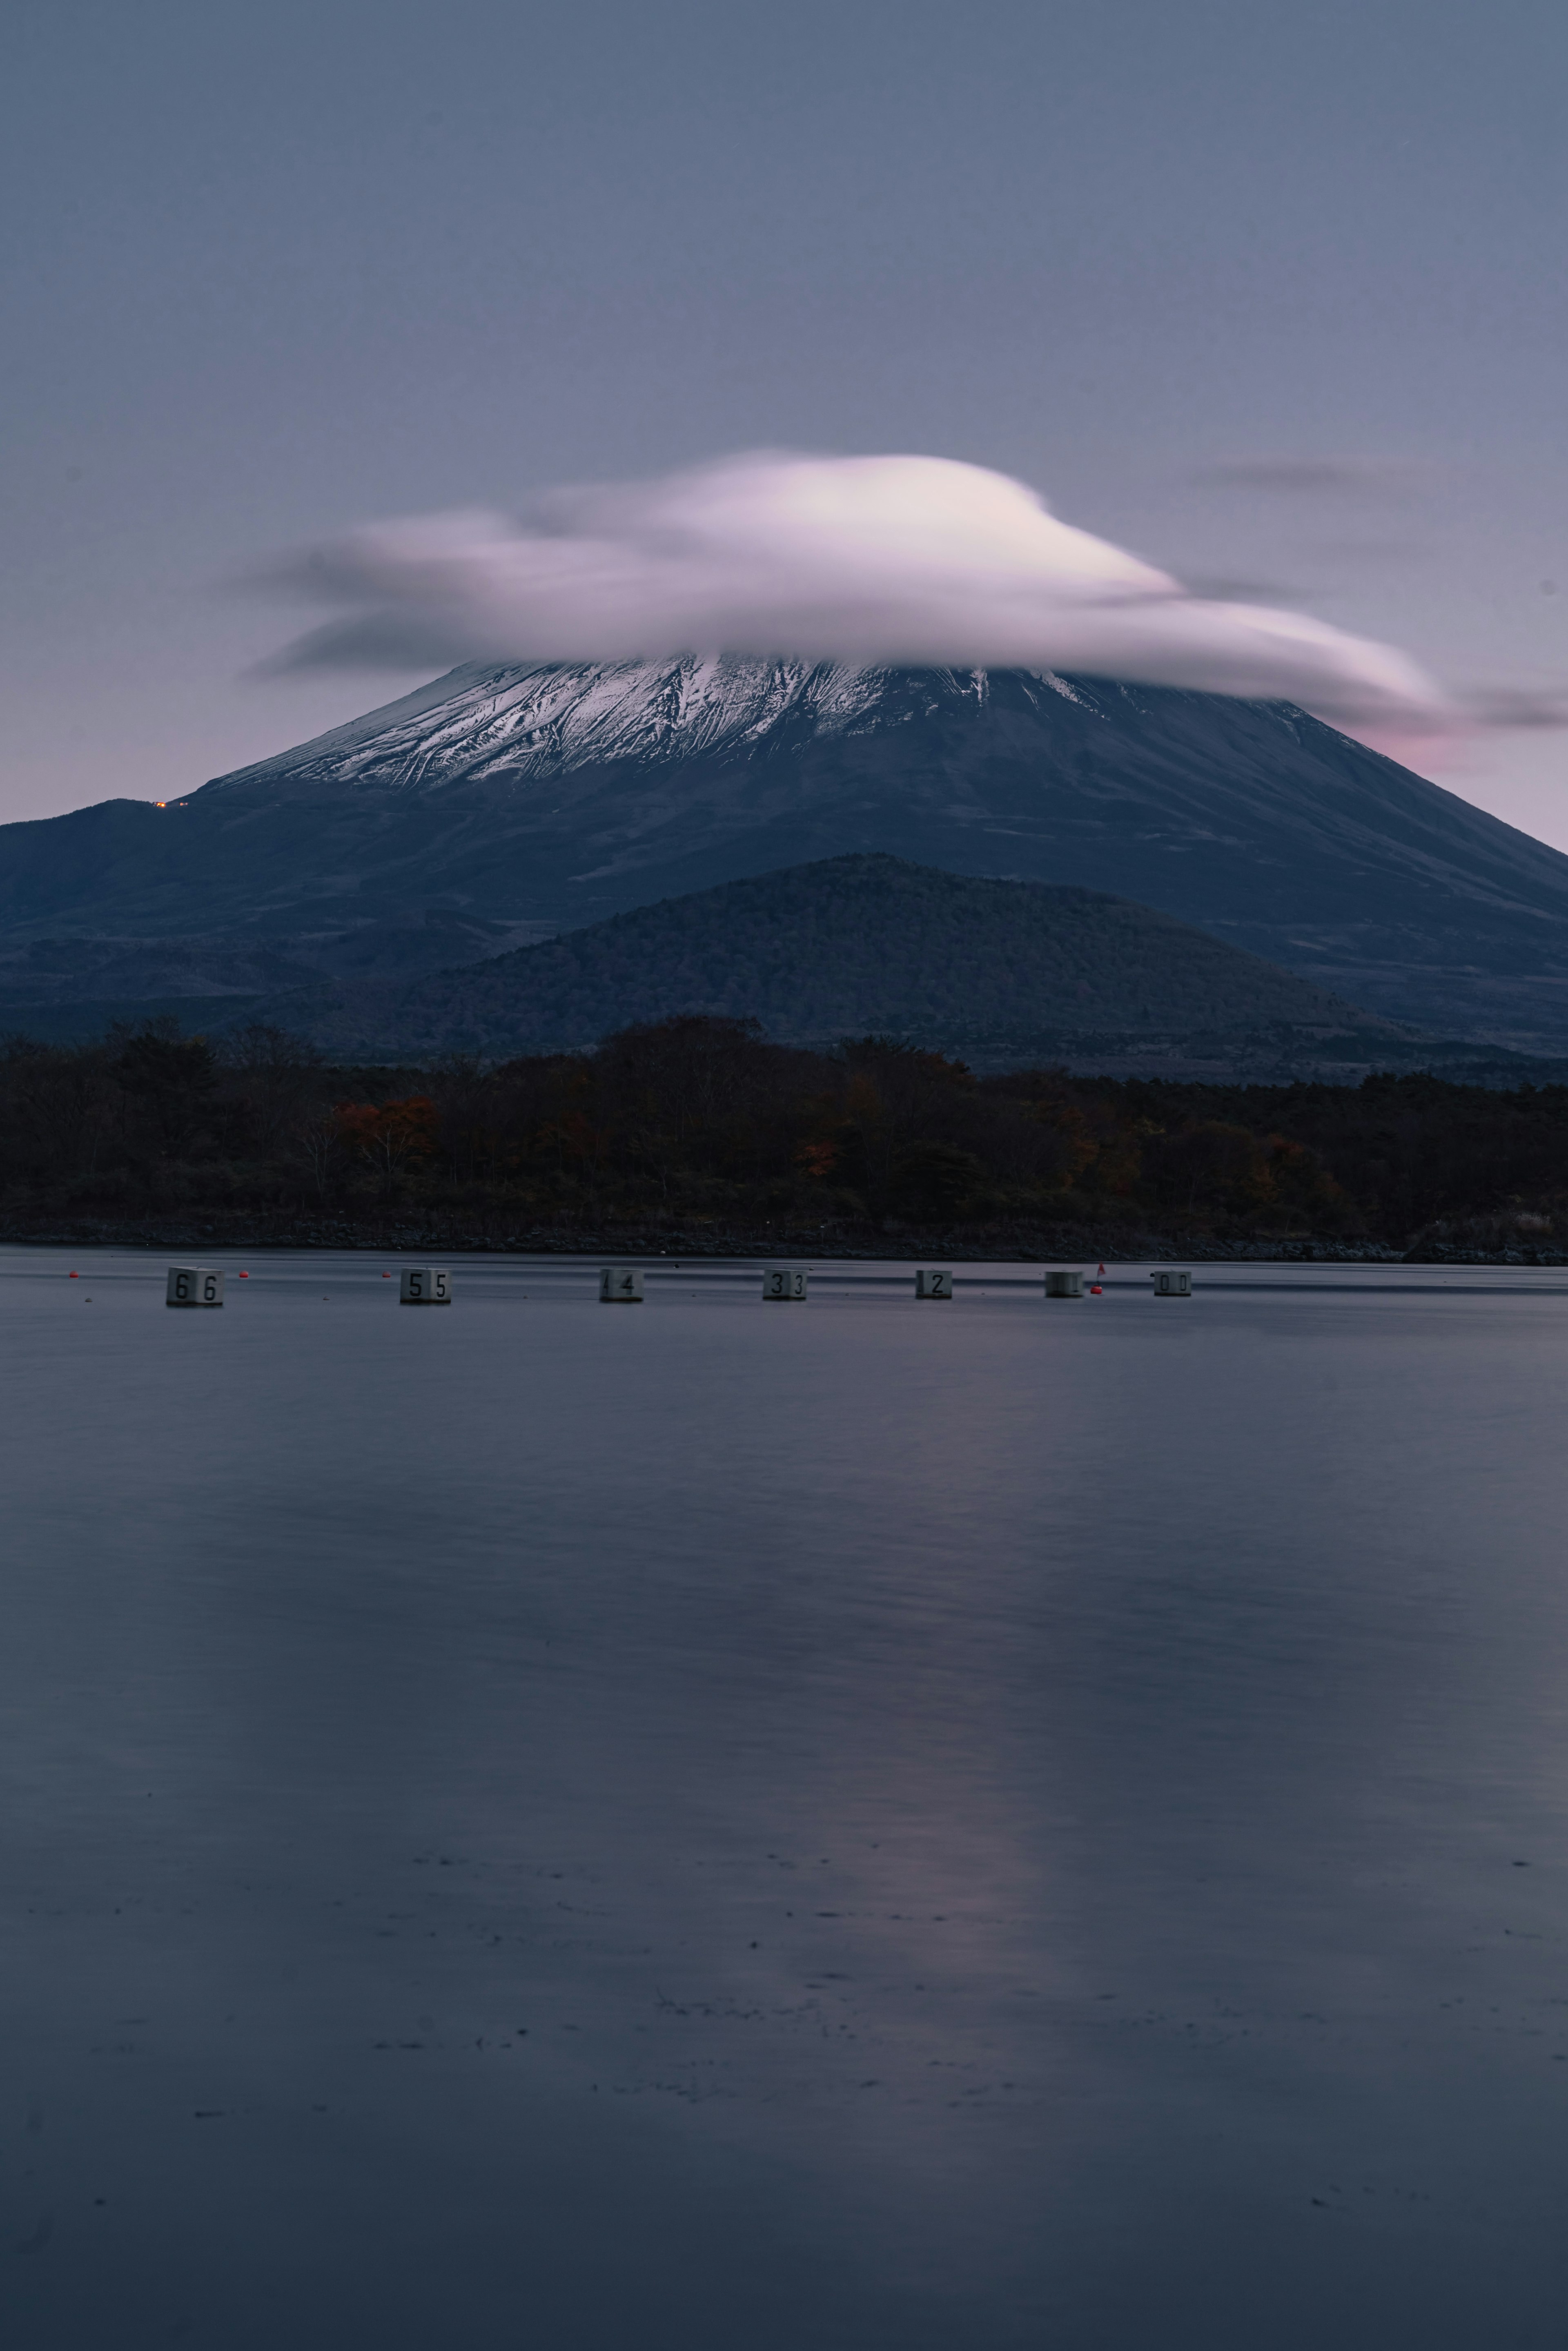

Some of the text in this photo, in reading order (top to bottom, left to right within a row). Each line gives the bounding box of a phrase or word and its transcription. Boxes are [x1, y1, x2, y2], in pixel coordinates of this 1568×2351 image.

[176, 1274, 189, 1299] 6
[204, 1276, 217, 1301] 6
[410, 1273, 422, 1297] 5
[437, 1275, 445, 1297] 5
[619, 1274, 635, 1295] 4
[771, 1273, 783, 1294] 3
[795, 1275, 802, 1295] 3
[932, 1275, 943, 1293] 2
